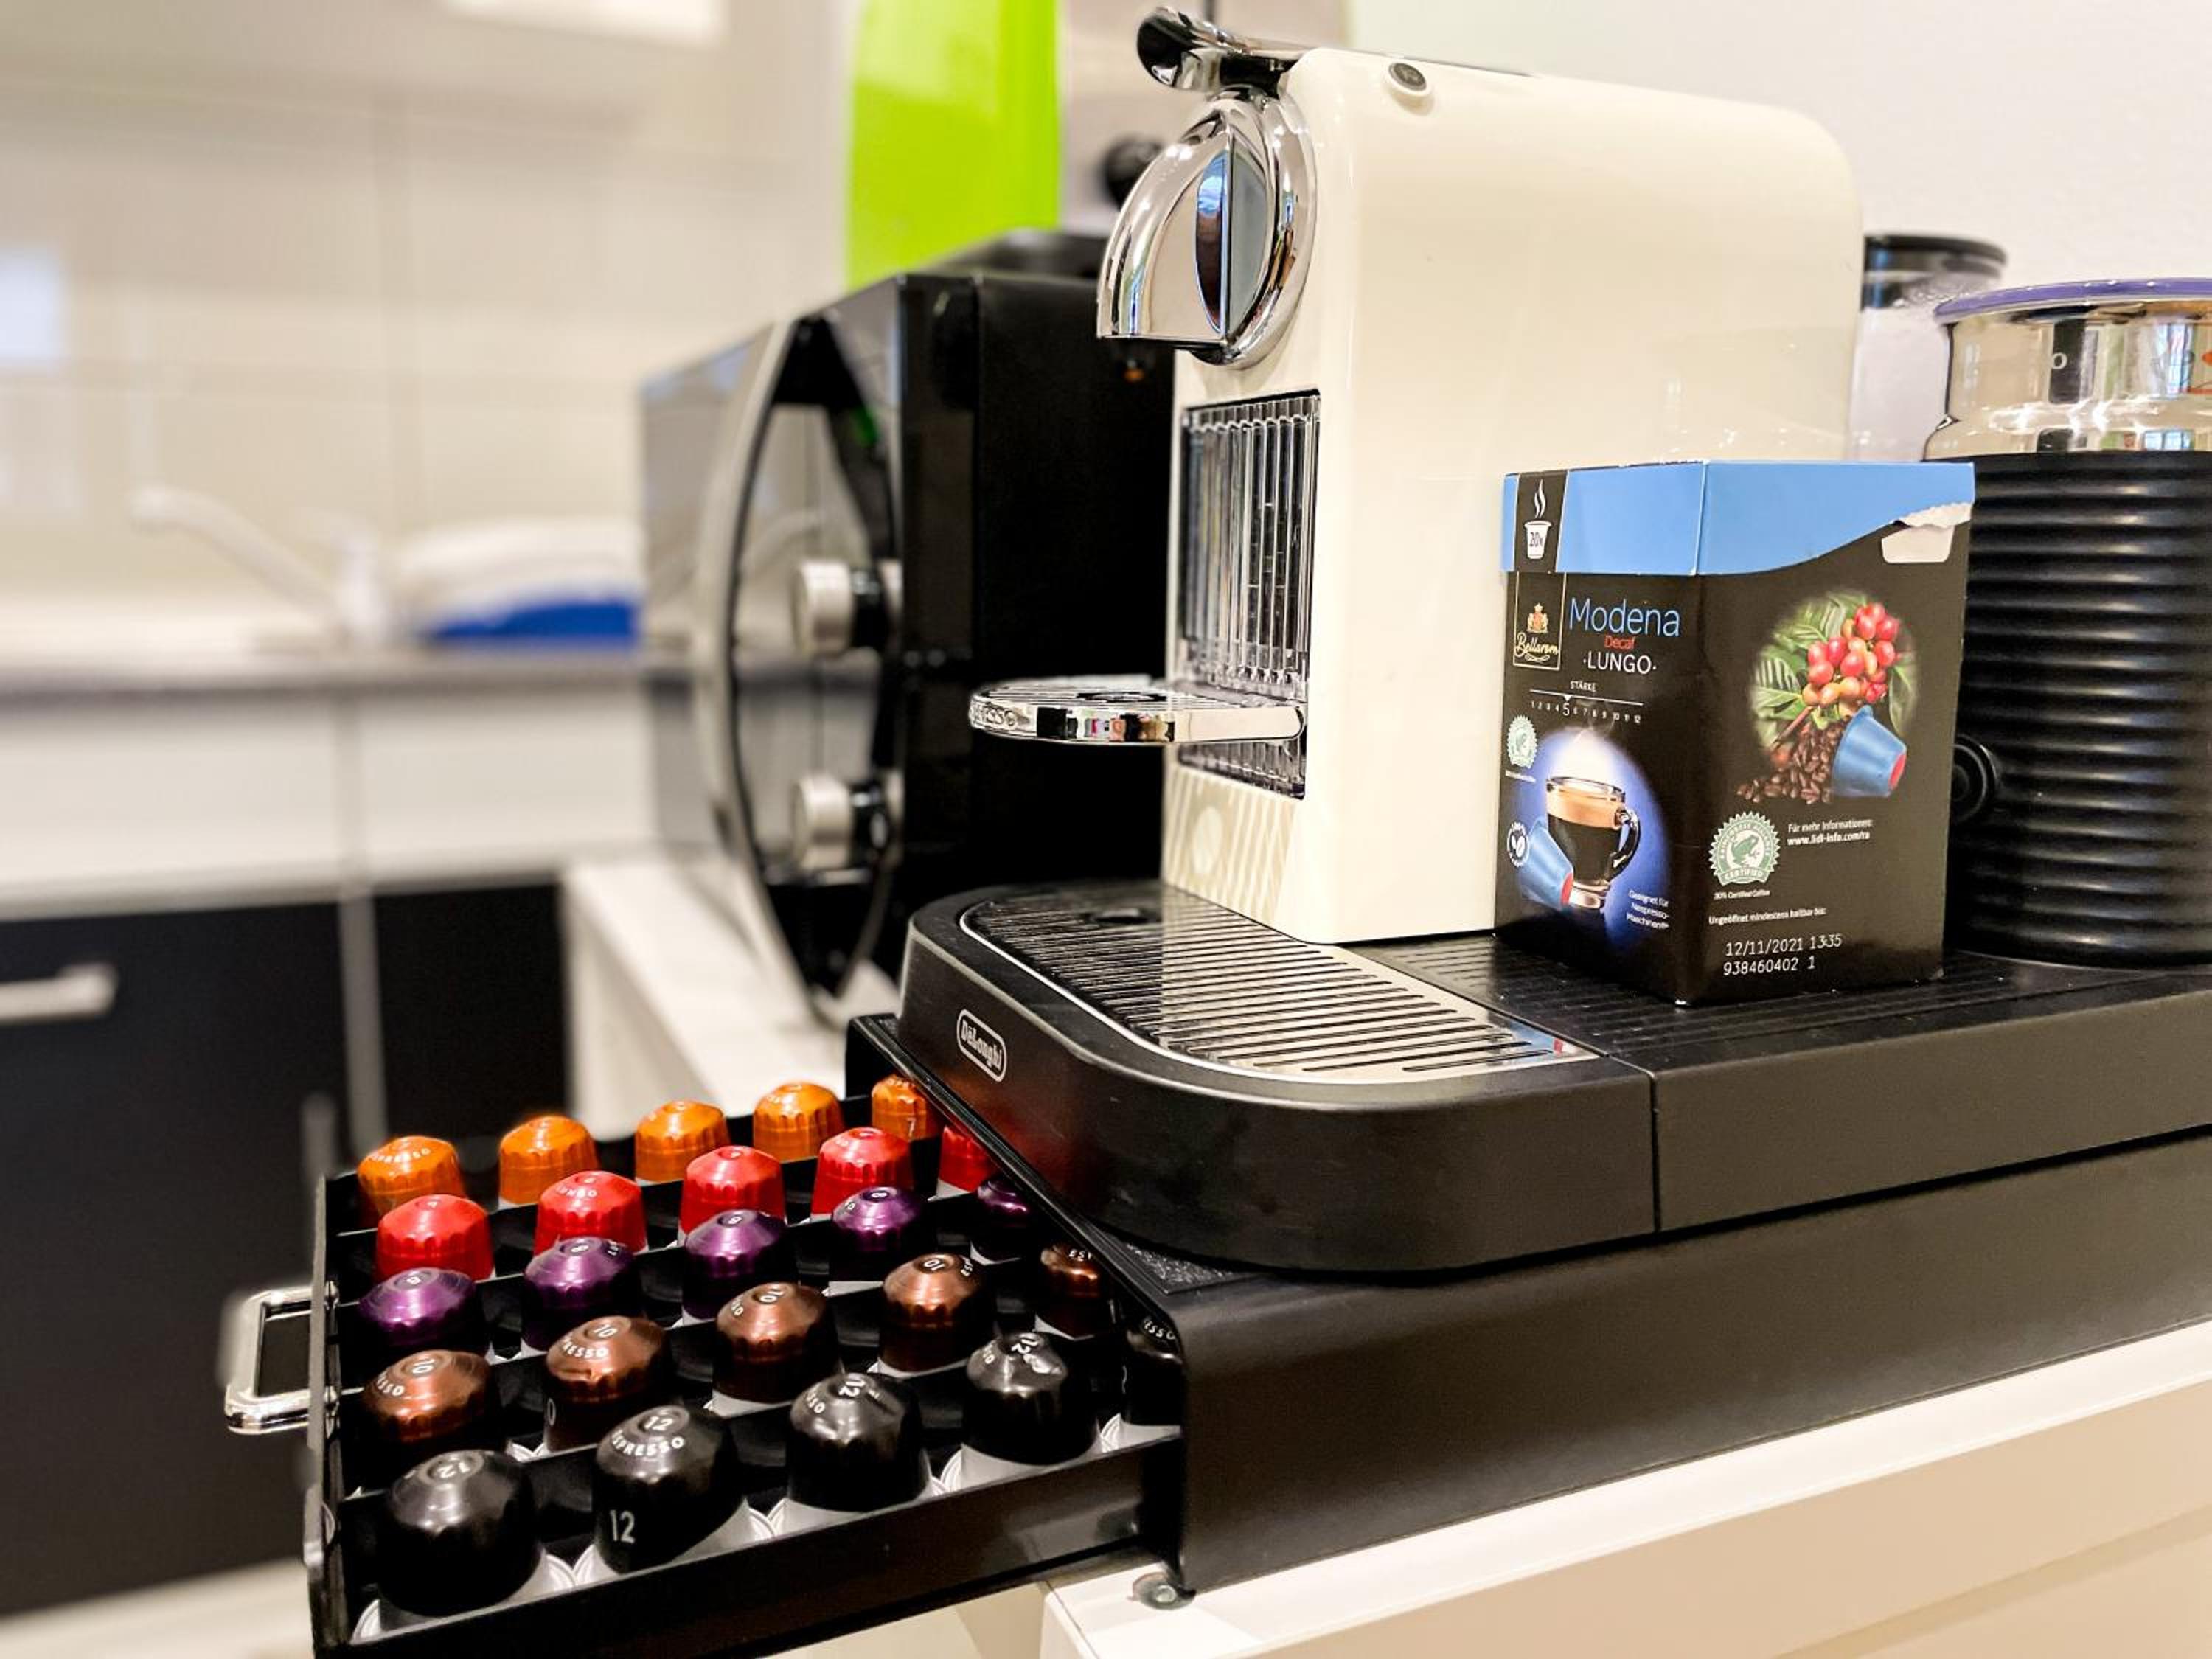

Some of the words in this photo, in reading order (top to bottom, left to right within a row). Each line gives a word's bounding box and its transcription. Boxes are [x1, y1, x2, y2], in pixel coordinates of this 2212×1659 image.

[1568, 597, 1680, 637] Modena
[1604, 635, 1635, 650] Decaf
[1725, 937, 1804, 957] 12/11/2021
[1723, 956, 1798, 976] 938460402
[1807, 956, 1816, 970] 1
[643, 1416, 674, 1431] 12
[609, 1509, 636, 1544] 12
